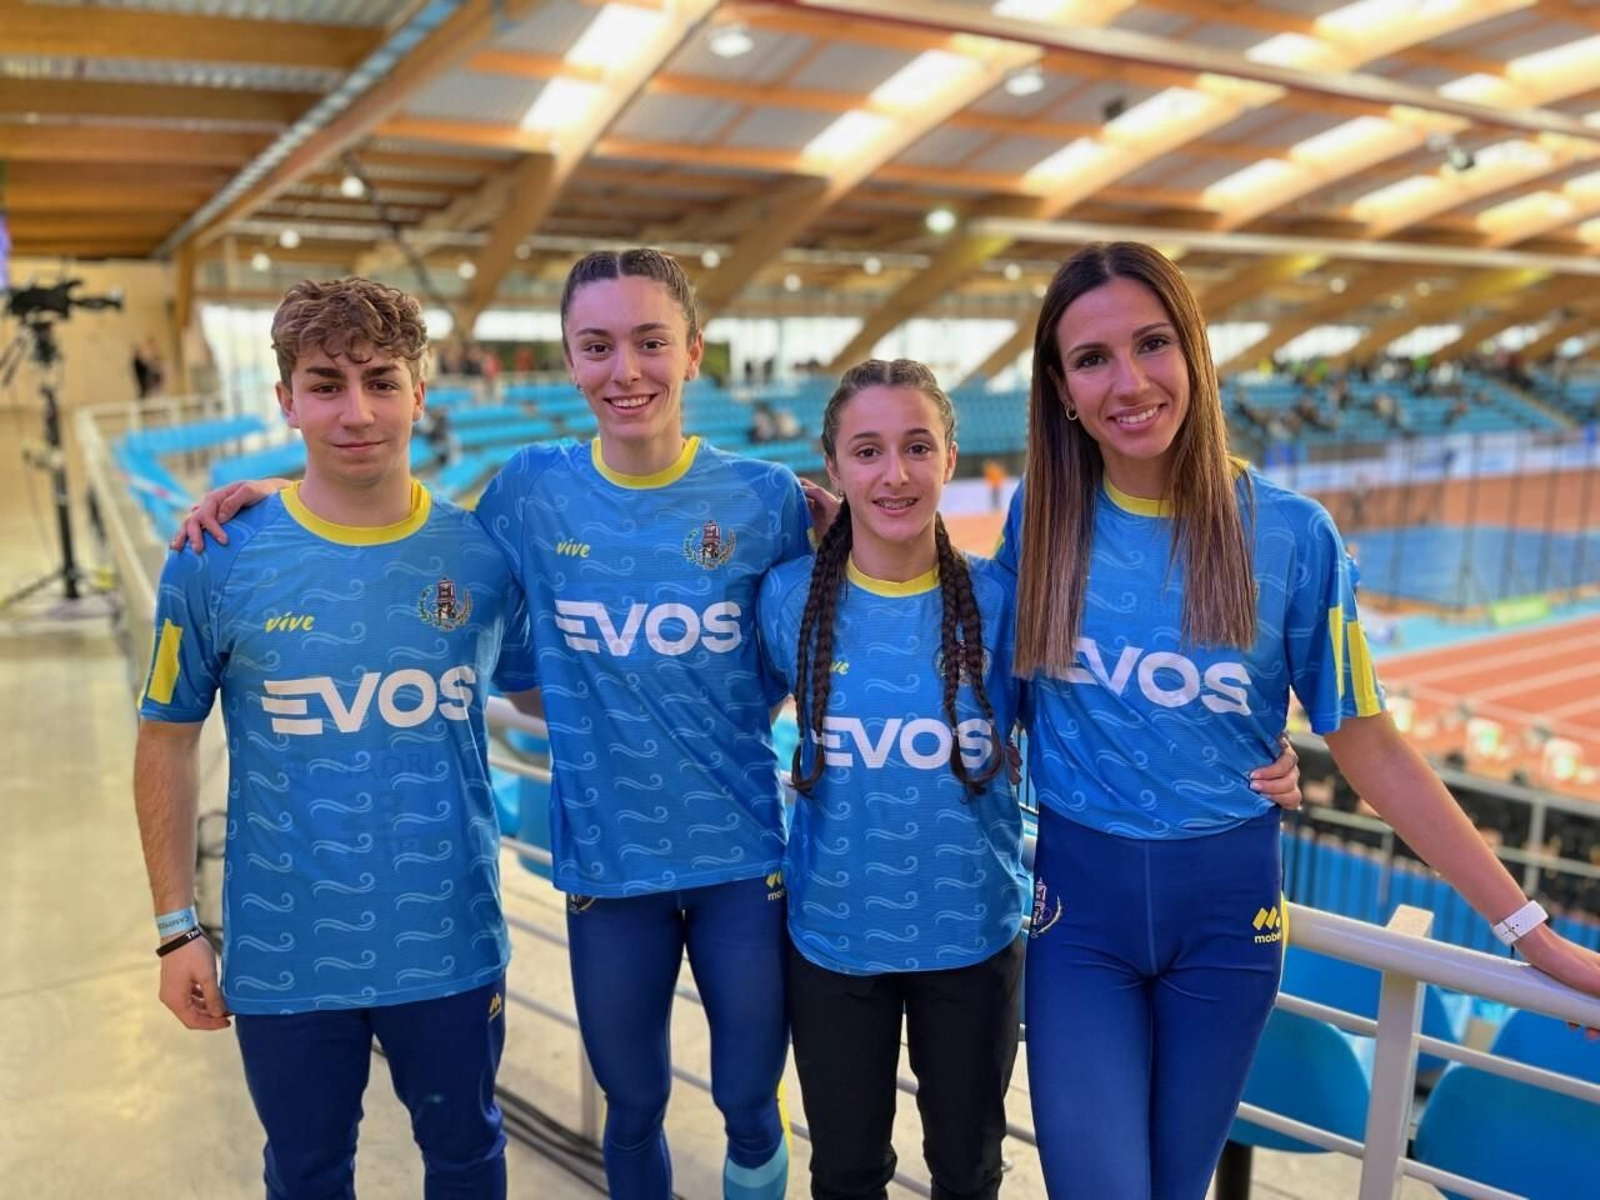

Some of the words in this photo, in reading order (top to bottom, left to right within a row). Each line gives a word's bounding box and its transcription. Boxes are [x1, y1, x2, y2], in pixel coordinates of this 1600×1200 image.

[554, 600, 742, 657] EVOS
[261, 664, 476, 736] EVOS
[810, 716, 993, 770] EVOS
